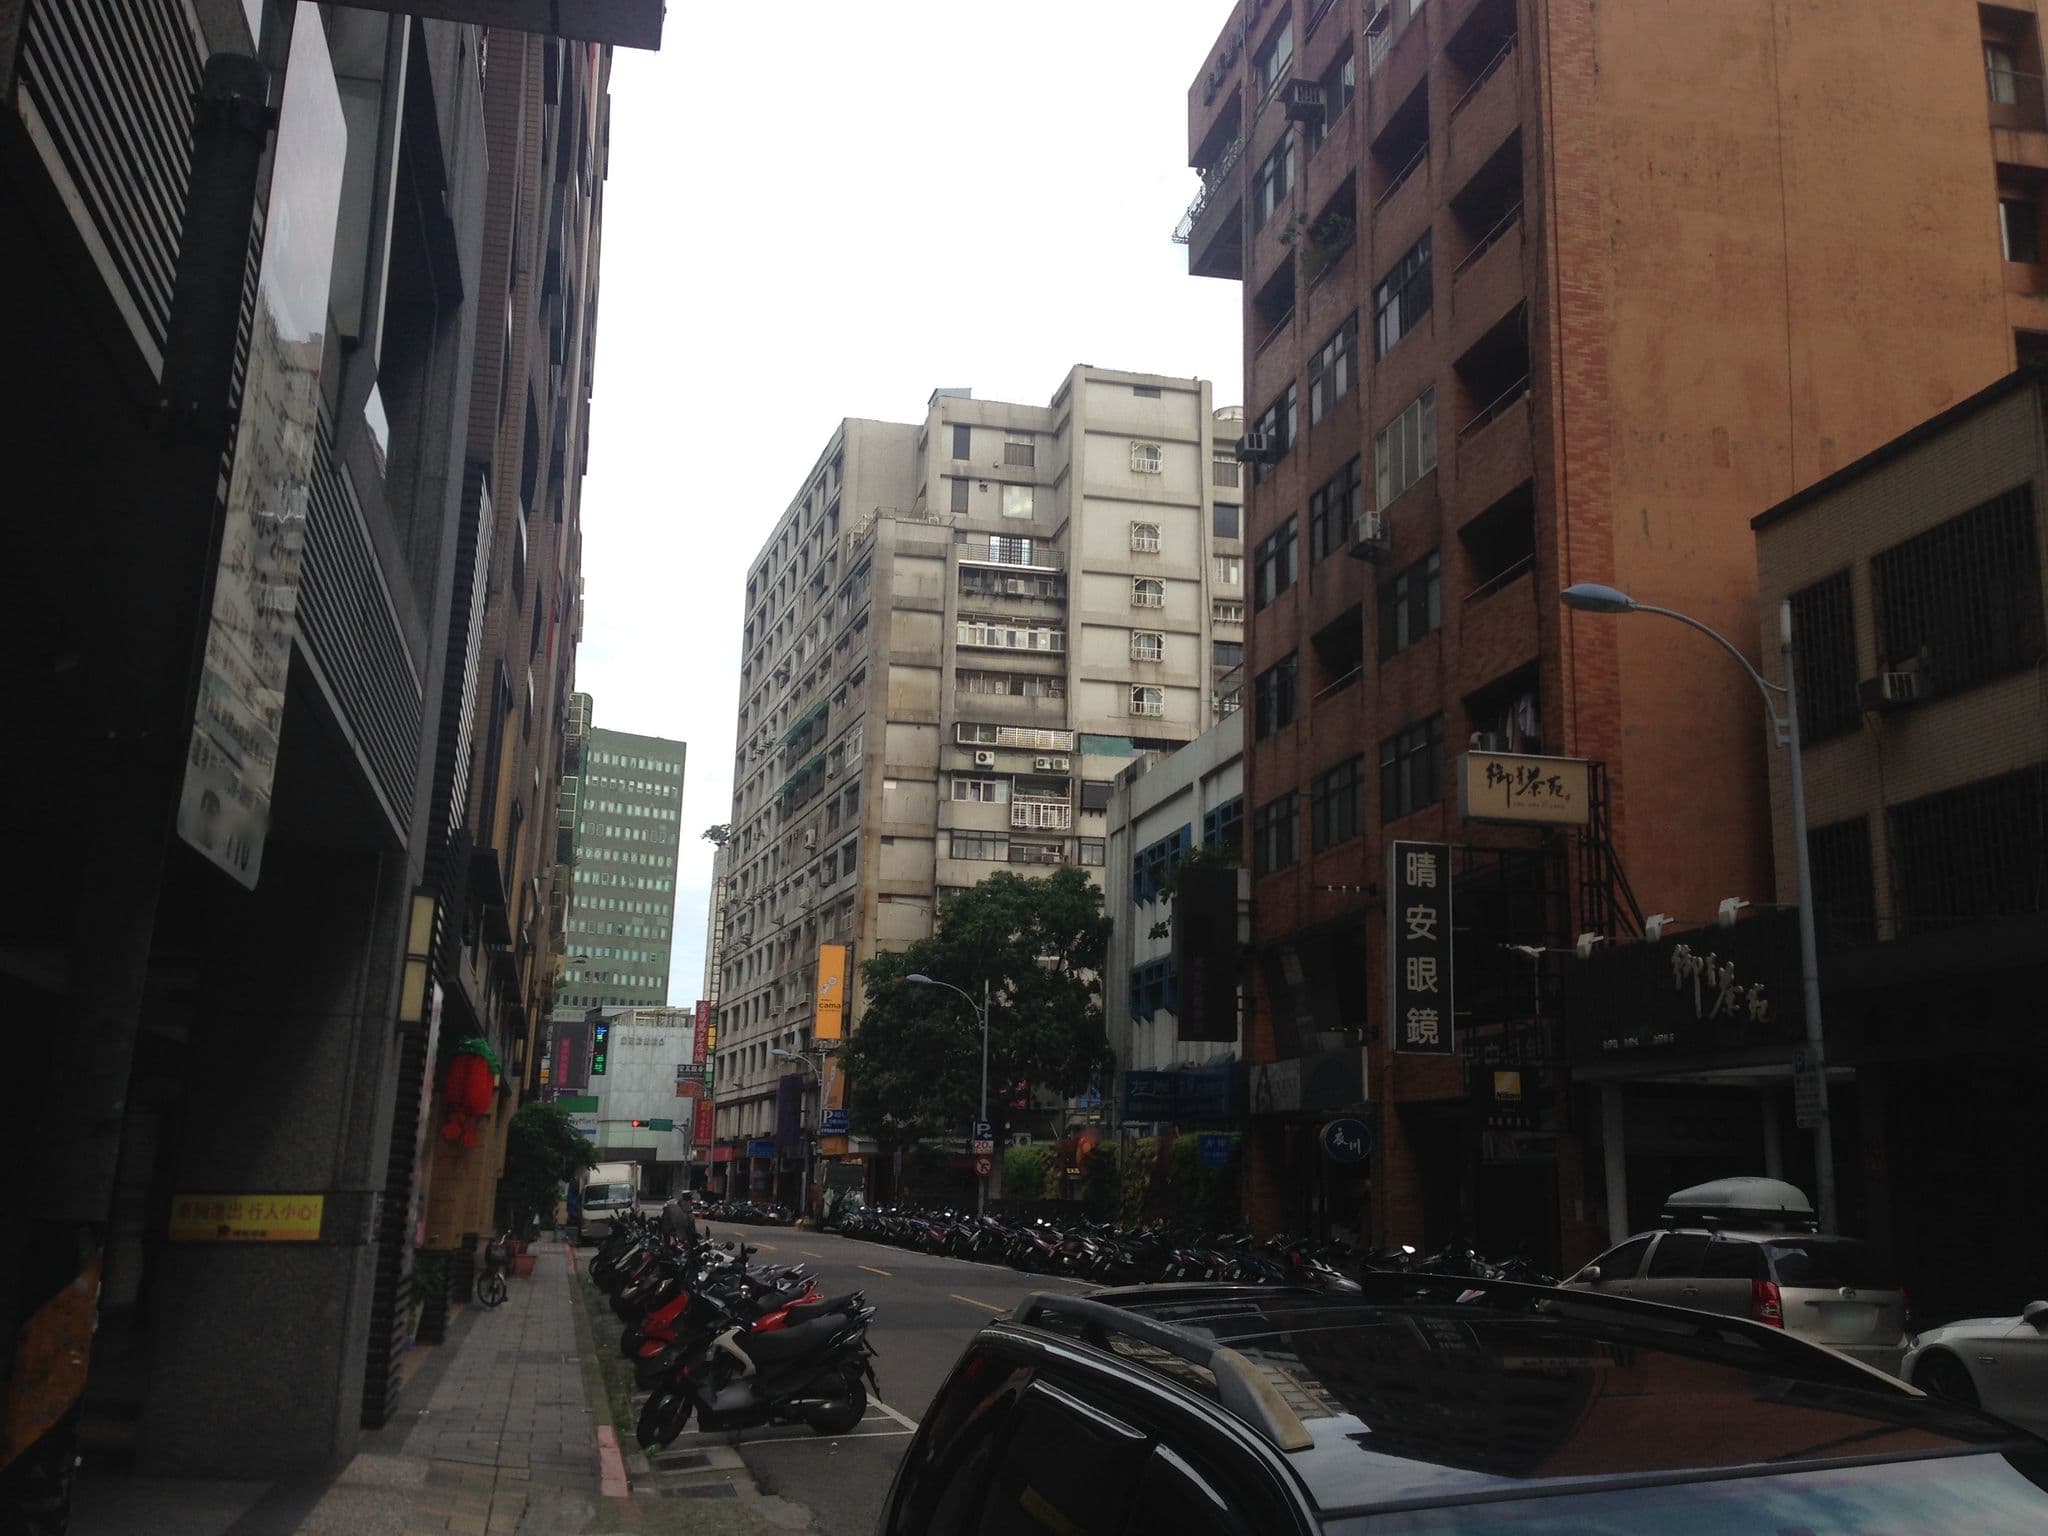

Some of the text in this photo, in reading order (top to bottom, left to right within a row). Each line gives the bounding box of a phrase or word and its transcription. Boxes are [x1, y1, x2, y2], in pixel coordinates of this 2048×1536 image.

[1405, 850, 1440, 1046] 晴安眼鏡
[819, 1002, 841, 1010] cama
[823, 1110, 834, 1124] P
[976, 1123, 991, 1136] P
[248, 1202, 318, 1221] 行人小心
